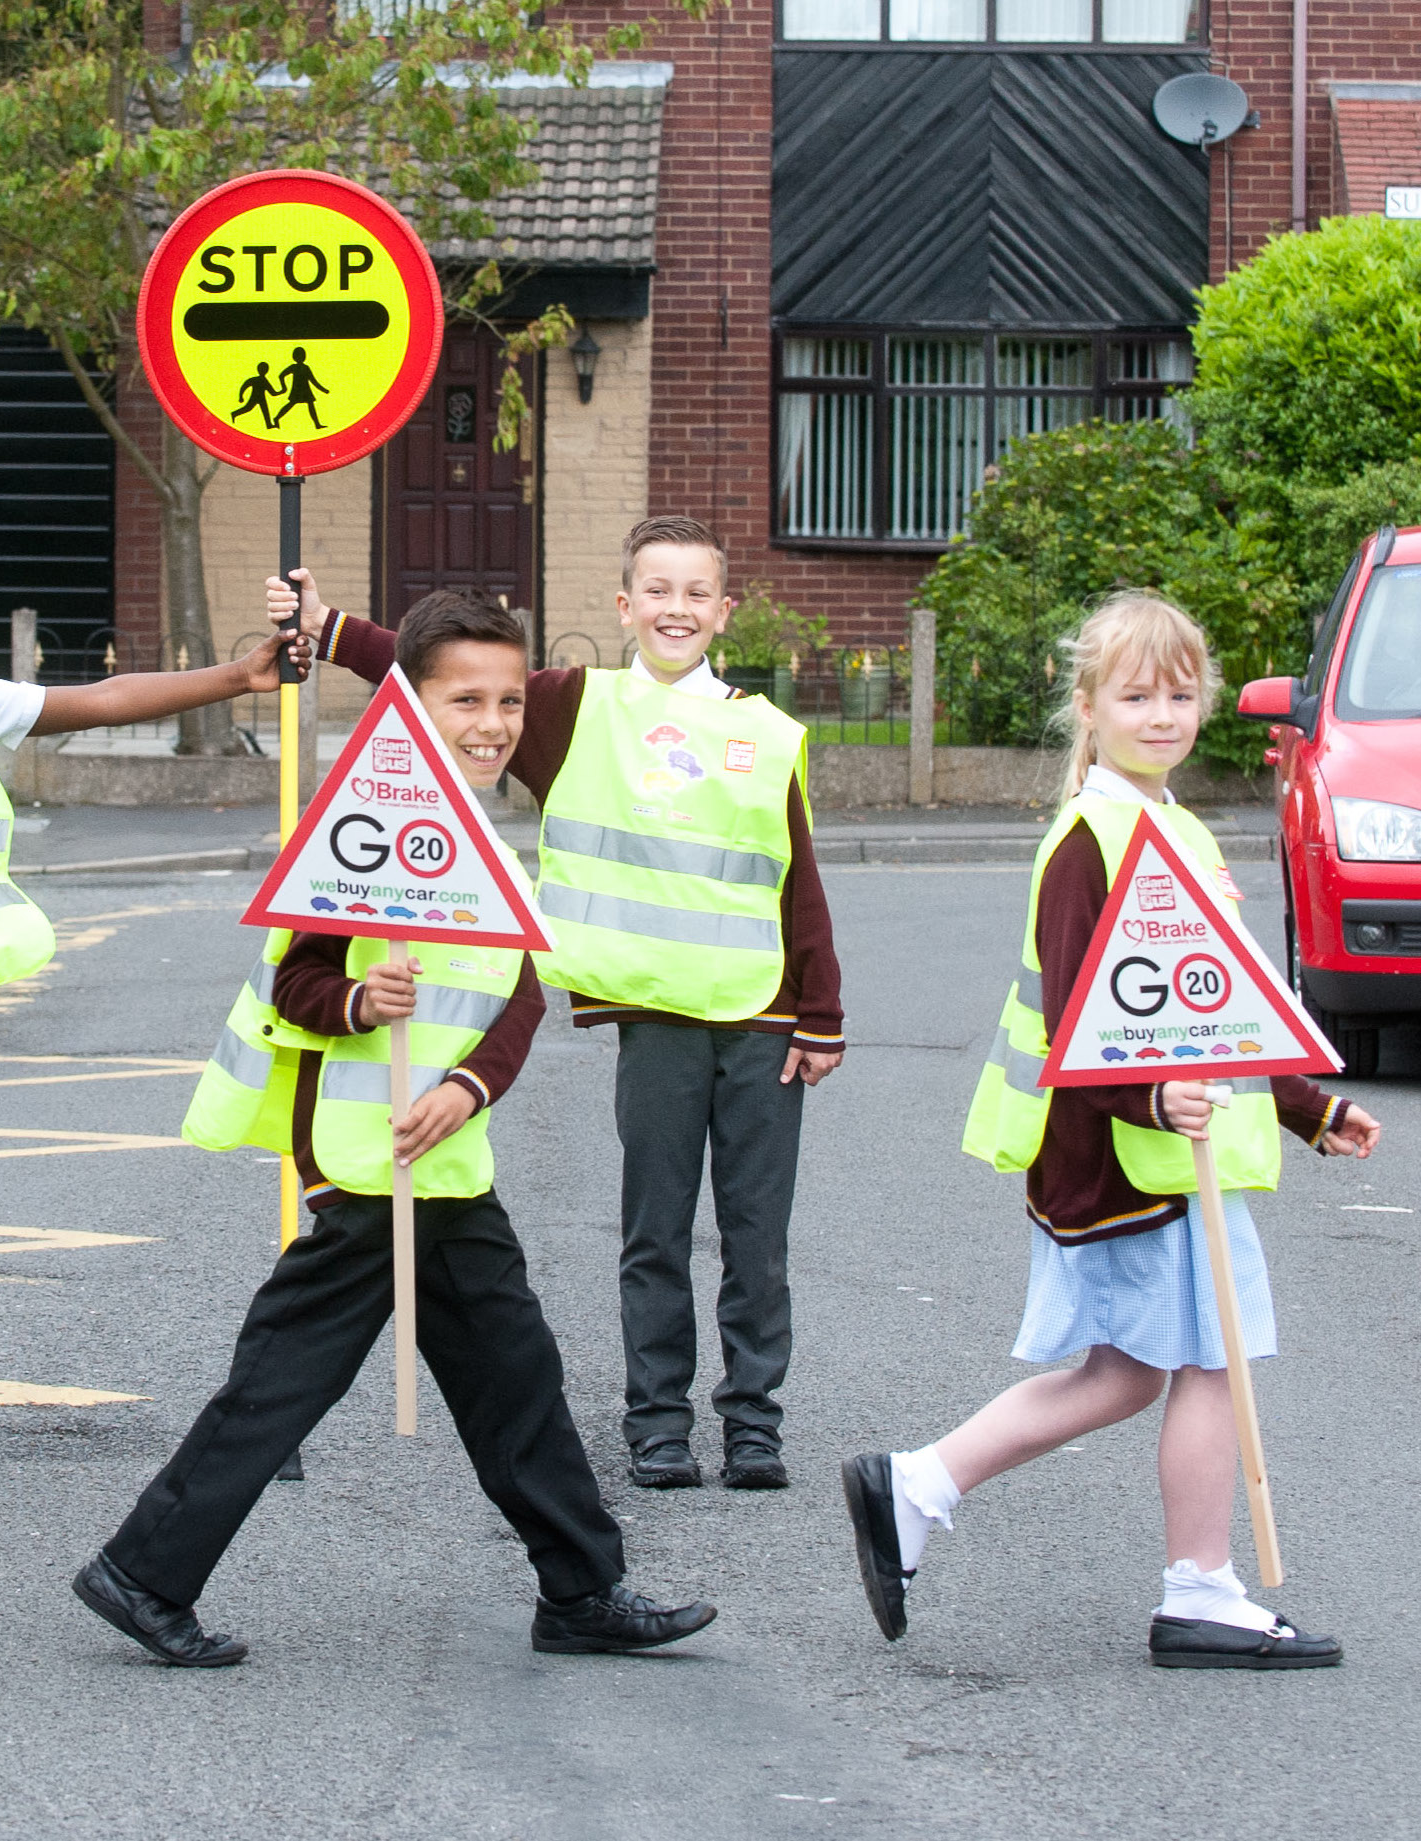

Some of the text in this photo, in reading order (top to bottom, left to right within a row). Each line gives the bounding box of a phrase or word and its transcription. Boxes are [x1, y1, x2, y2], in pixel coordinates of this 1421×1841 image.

[198, 244, 374, 294] STOP
[377, 782, 439, 803] Brake
[409, 836, 443, 861] 20
[310, 878, 479, 905] webuyanycar.com
[1146, 919, 1206, 938] Brake
[1186, 970, 1219, 995] 20
[1097, 1022, 1261, 1043] webuyanycar.com
